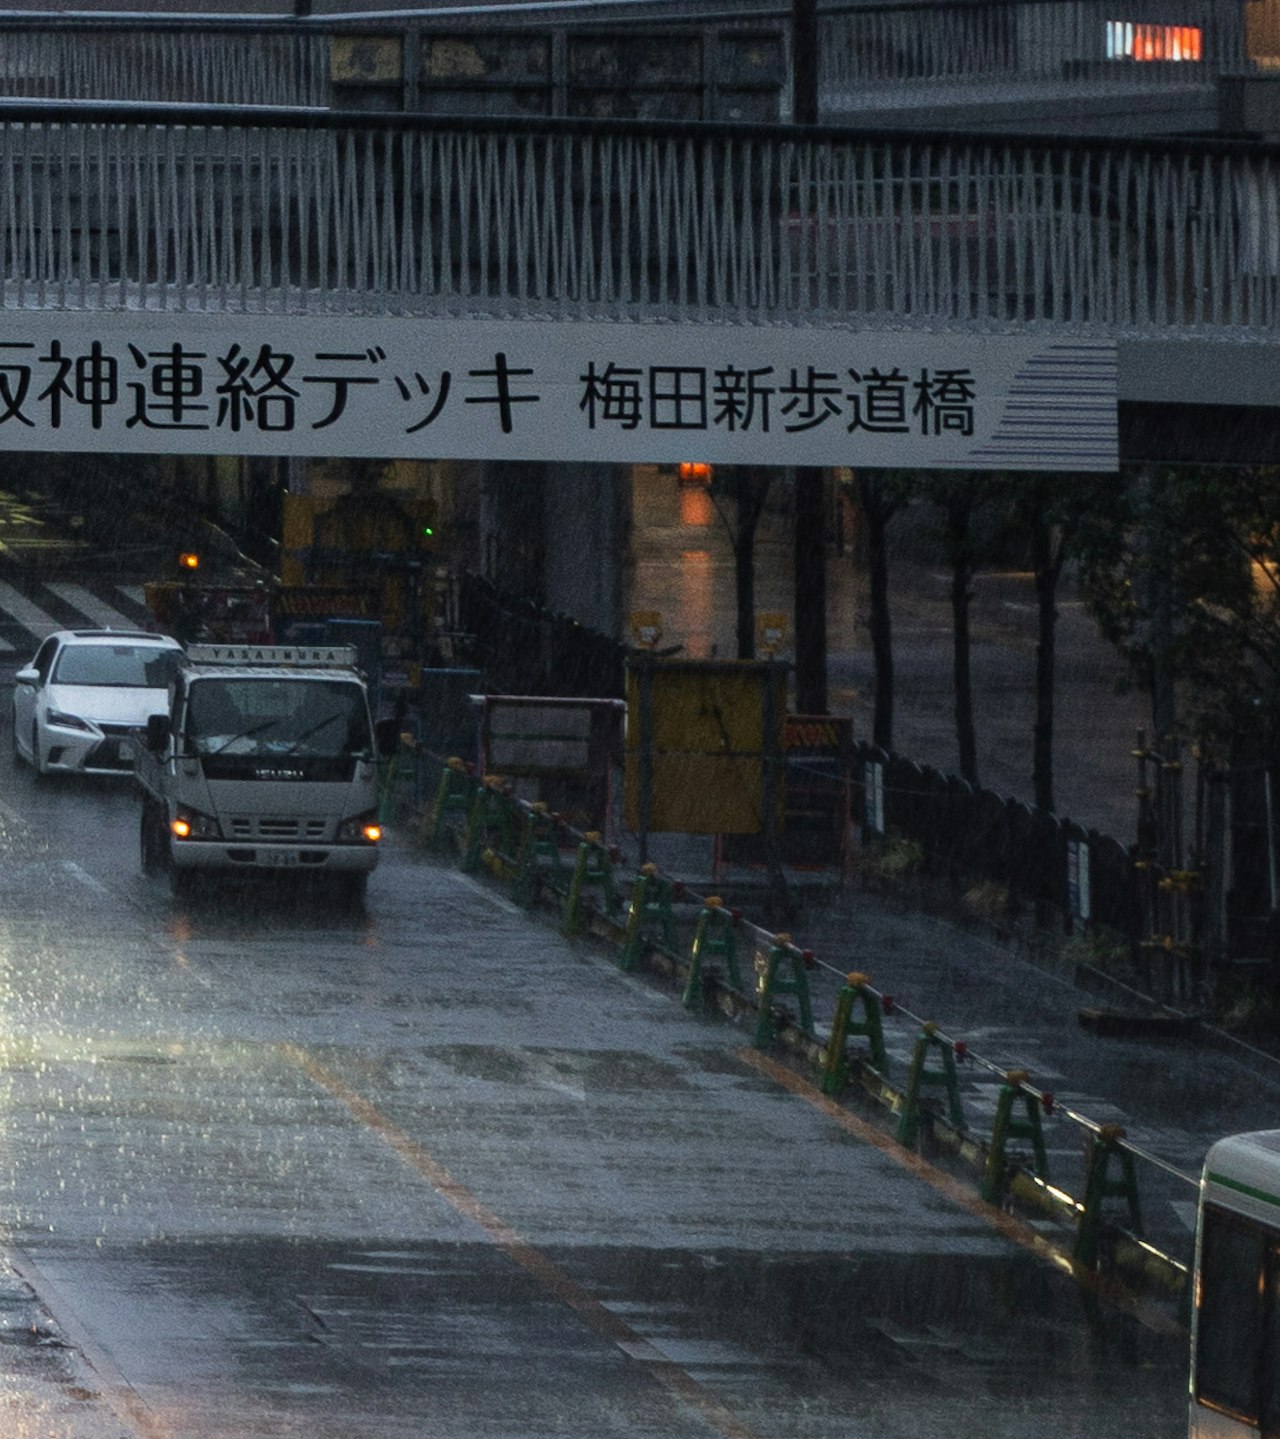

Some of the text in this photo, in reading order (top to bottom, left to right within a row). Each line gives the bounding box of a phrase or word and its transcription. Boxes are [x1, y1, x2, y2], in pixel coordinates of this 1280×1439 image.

[579, 360, 978, 438] 梅田新歩道橋
[212, 648, 336, 660] YASAIMURA
